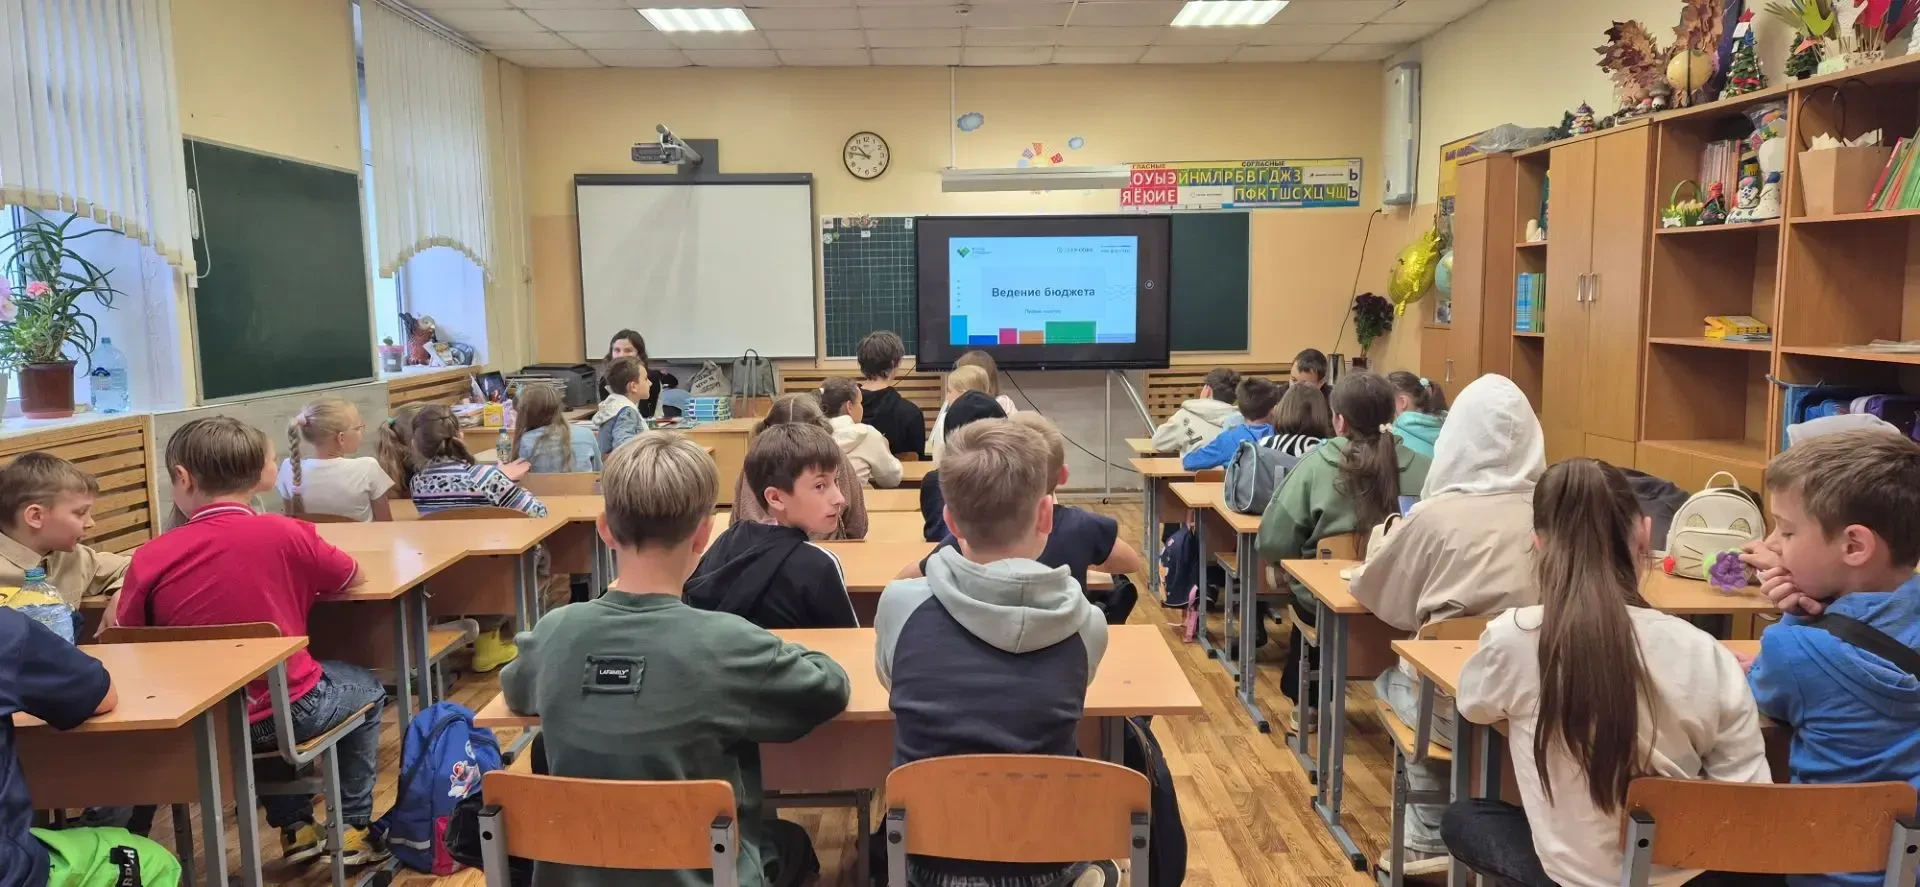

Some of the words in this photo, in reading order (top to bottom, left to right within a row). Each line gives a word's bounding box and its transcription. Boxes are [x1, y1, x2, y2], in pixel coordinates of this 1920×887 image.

[1241, 160, 1285, 168] СОГЛАСНЫЕ
[991, 287, 1041, 298] Ведение
[1044, 287, 1096, 298] бюджета
